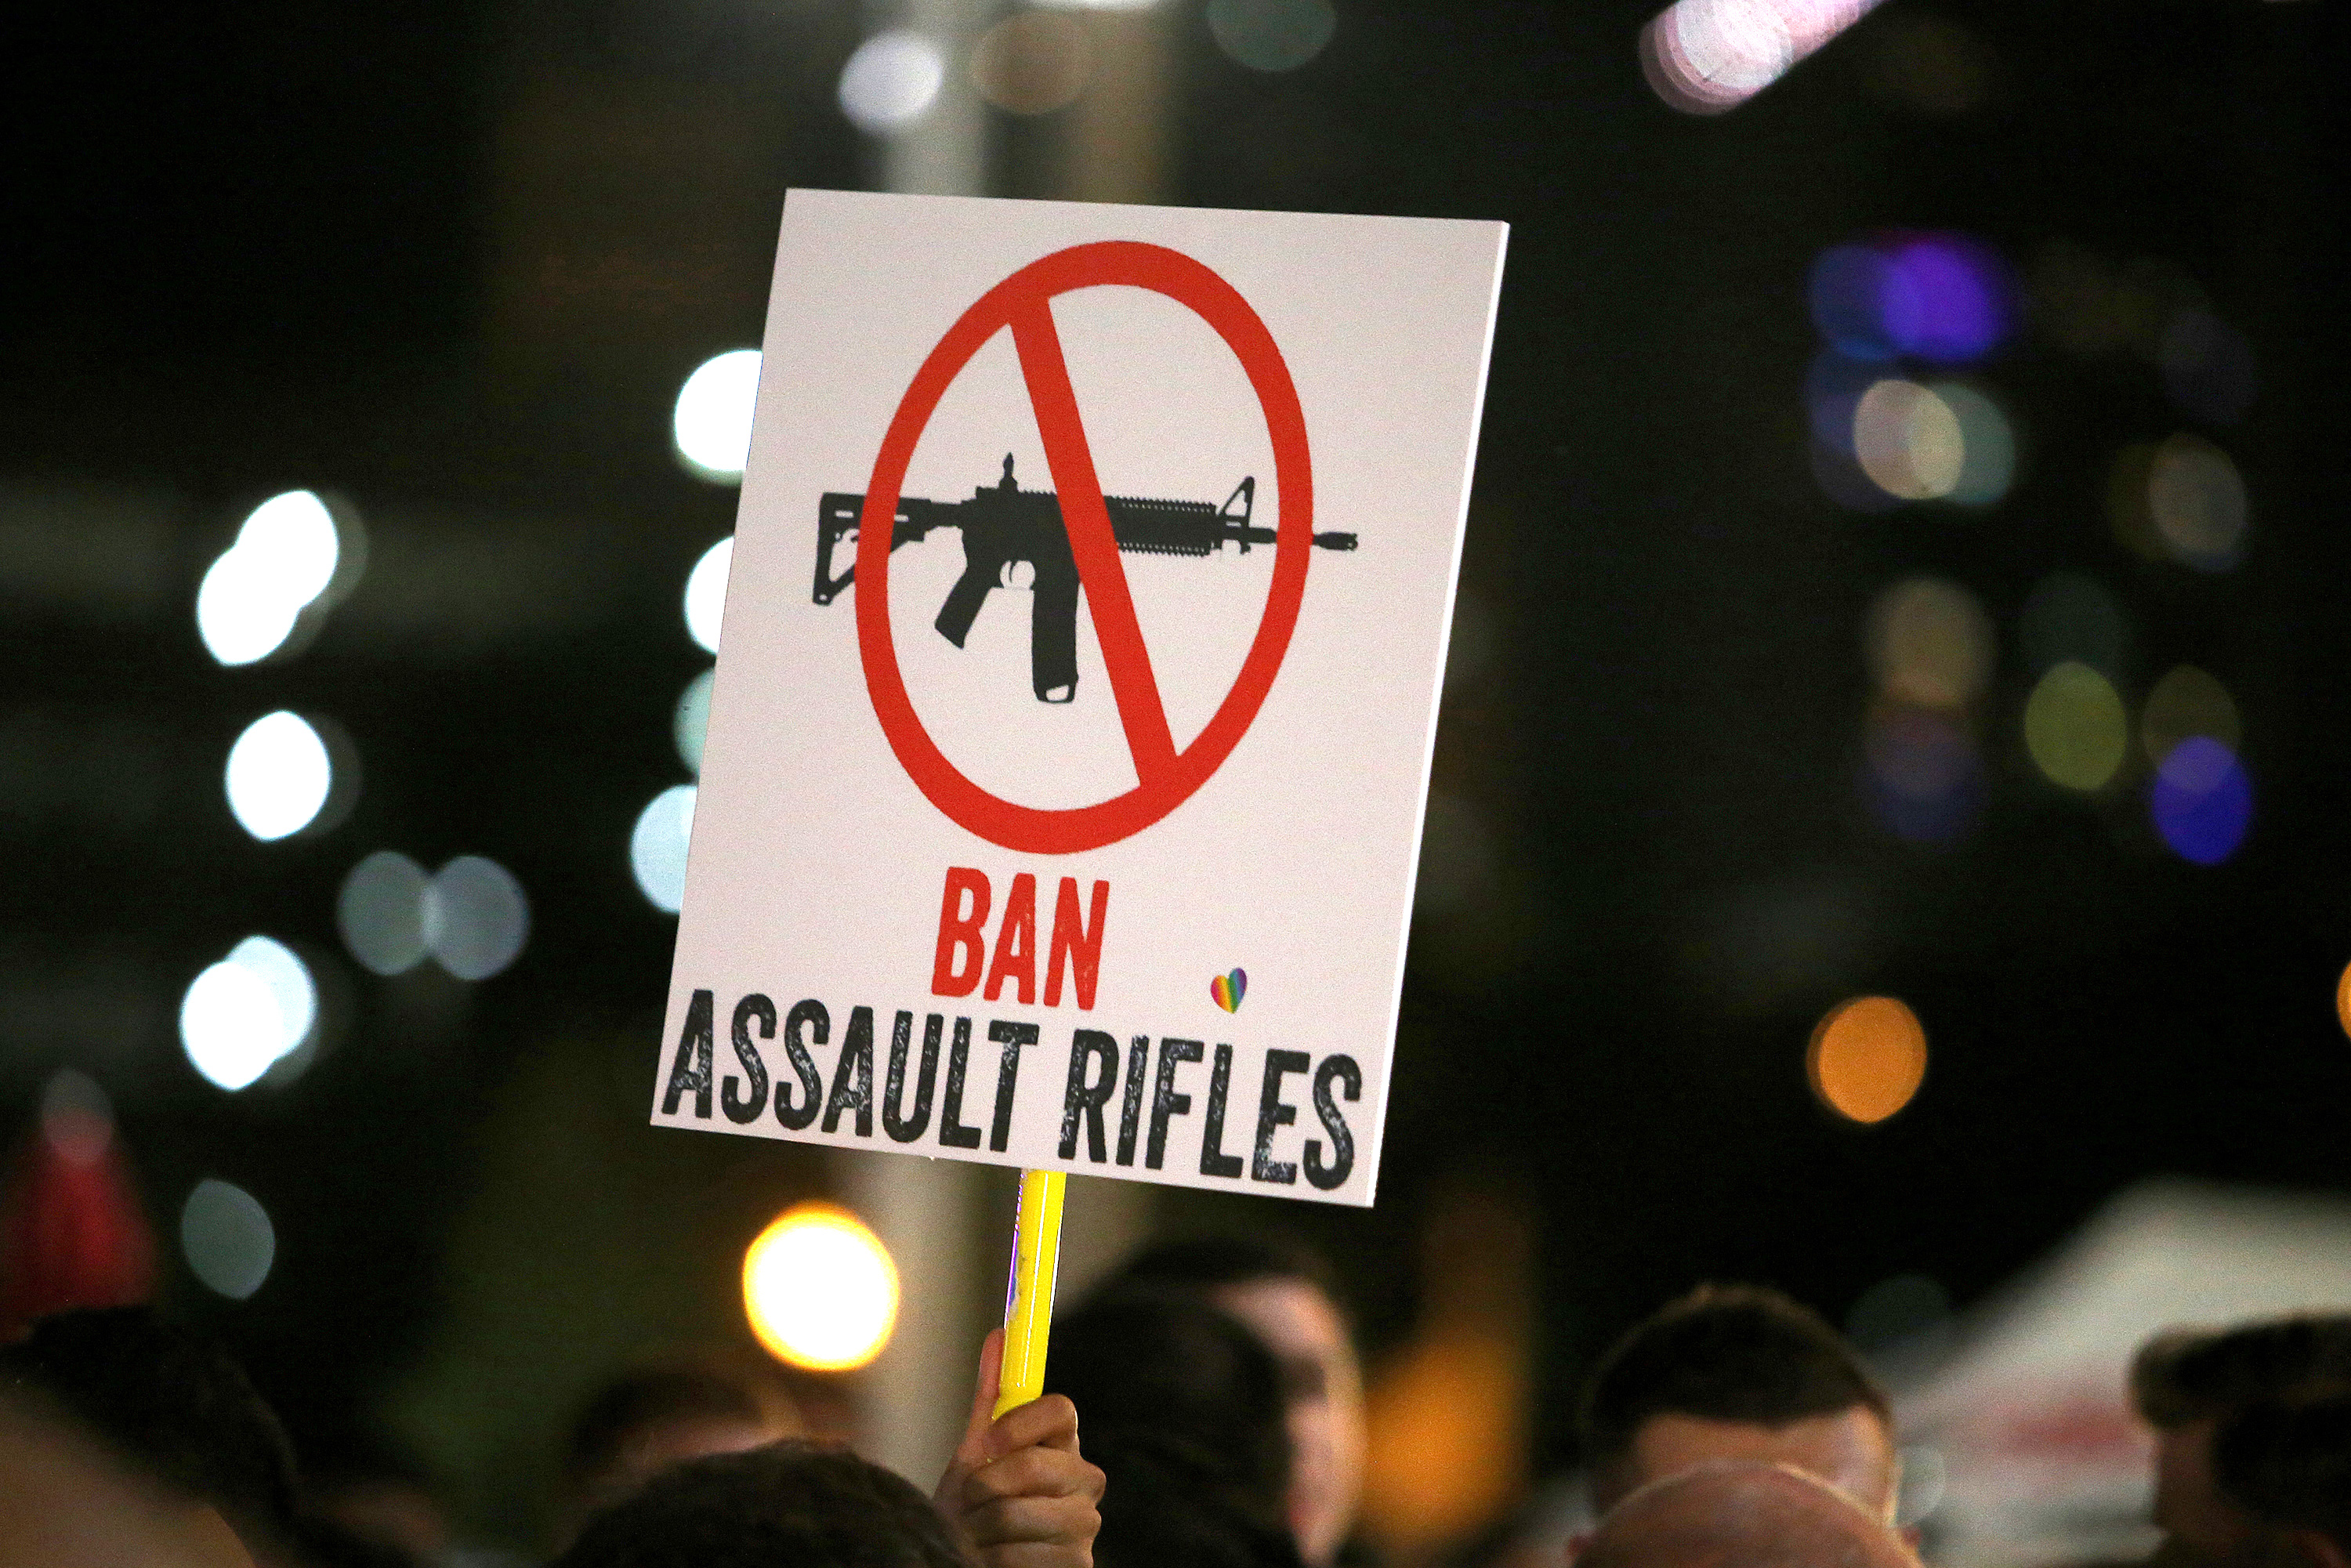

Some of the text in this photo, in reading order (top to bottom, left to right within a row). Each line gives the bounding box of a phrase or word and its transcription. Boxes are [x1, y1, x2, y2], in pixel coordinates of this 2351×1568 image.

[931, 867, 1110, 1011] BAN
[661, 989, 1362, 1190] ASSAULT RIFLES
